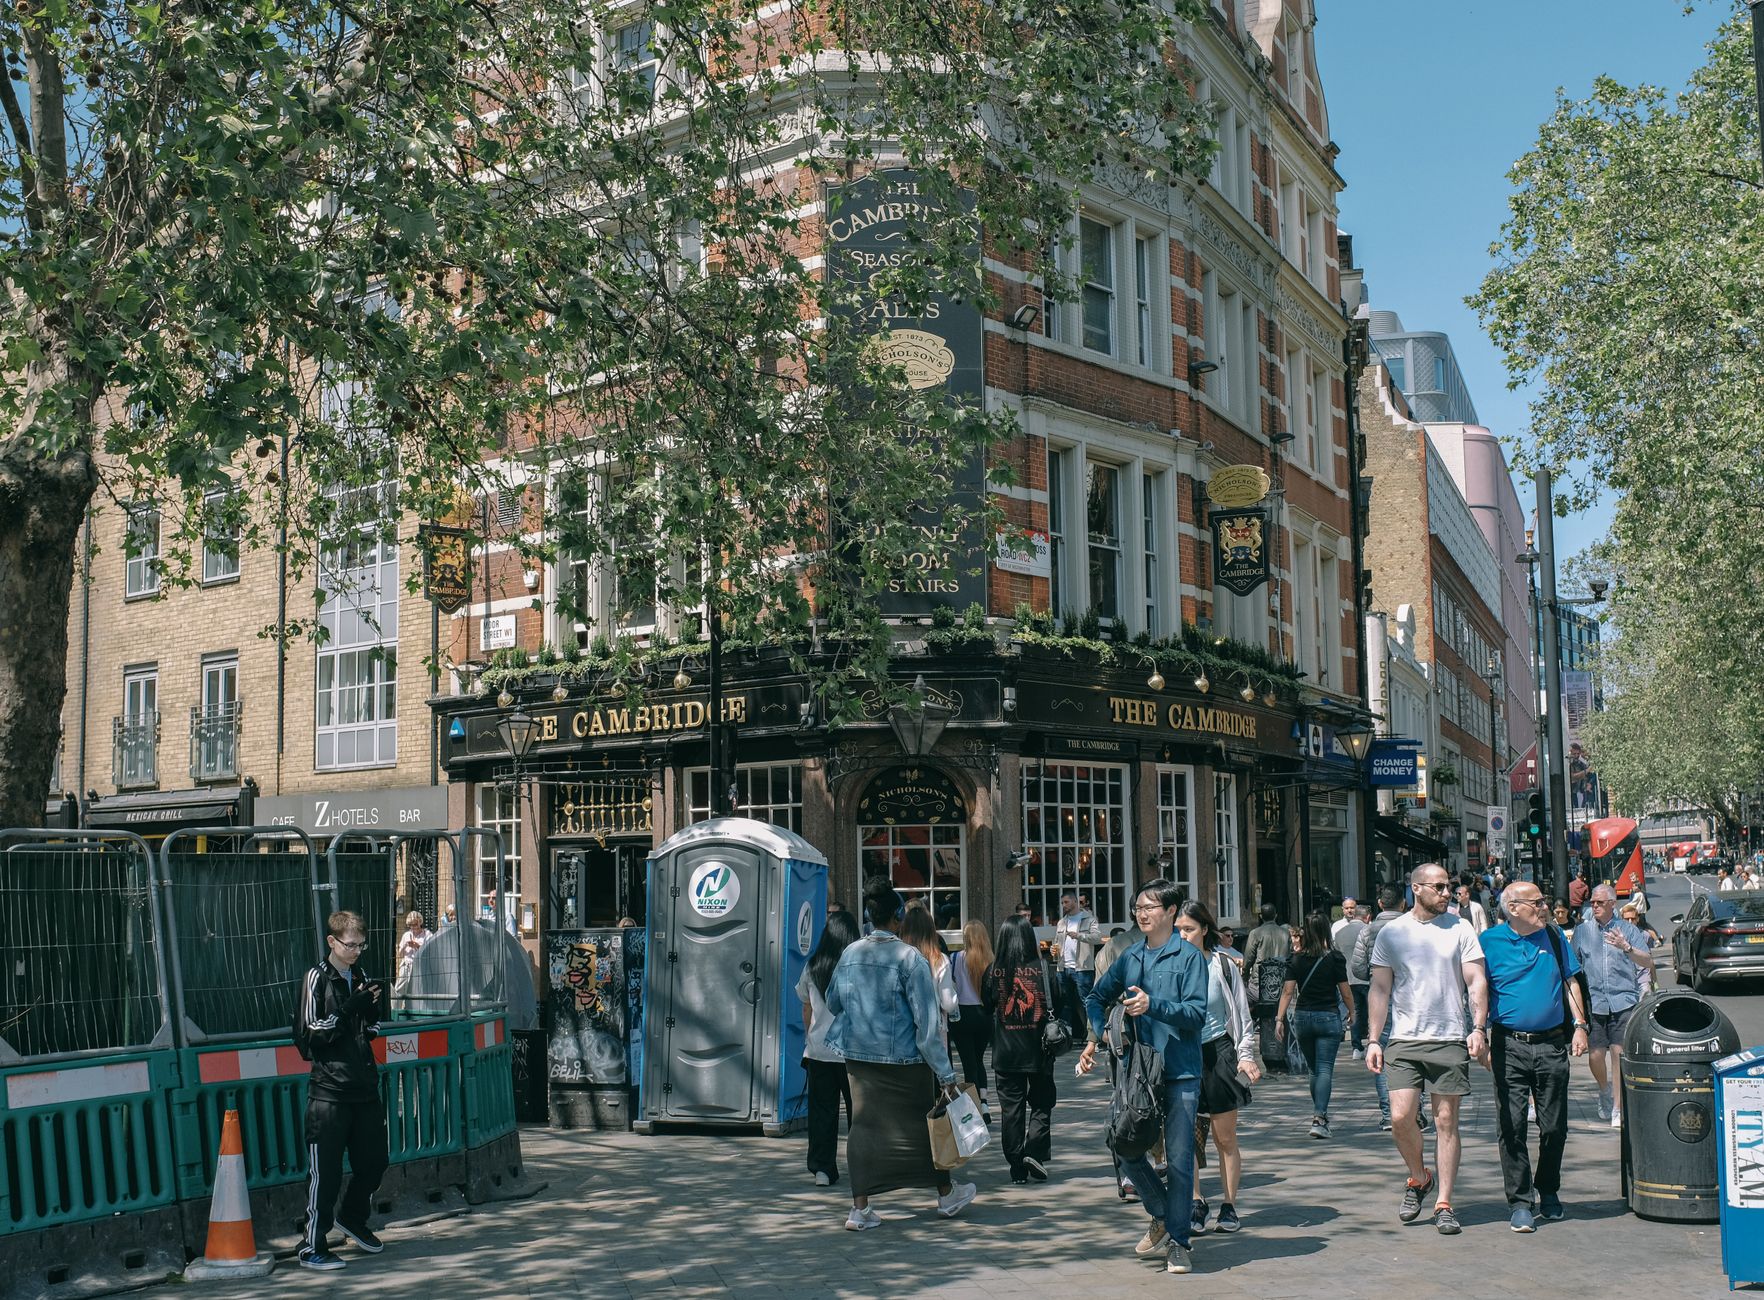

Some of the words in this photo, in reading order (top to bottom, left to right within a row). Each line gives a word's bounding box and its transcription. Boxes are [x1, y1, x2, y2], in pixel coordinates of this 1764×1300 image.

[1219, 567, 1265, 578] CAMBRIDGE
[429, 586, 467, 596] CAMBRIDGE
[483, 629, 503, 641] STREET
[1109, 697, 1158, 727] THE
[1168, 703, 1257, 739] CAMBRIDGE
[1067, 739, 1080, 749] THE
[1081, 740, 1121, 751] CAMBRIDGE
[1373, 758, 1414, 767] CHANGE
[1373, 766, 1414, 776] MONEY
[878, 786, 948, 800] NICHOLSON'S
[126, 811, 158, 822] MEXICAN
[160, 809, 183, 820] GRILL
[314, 801, 330, 827] Z
[331, 807, 379, 826] HOTELS
[399, 808, 421, 823] BAR
[697, 898, 728, 906] NIXON
[1666, 1046, 1691, 1054] general
